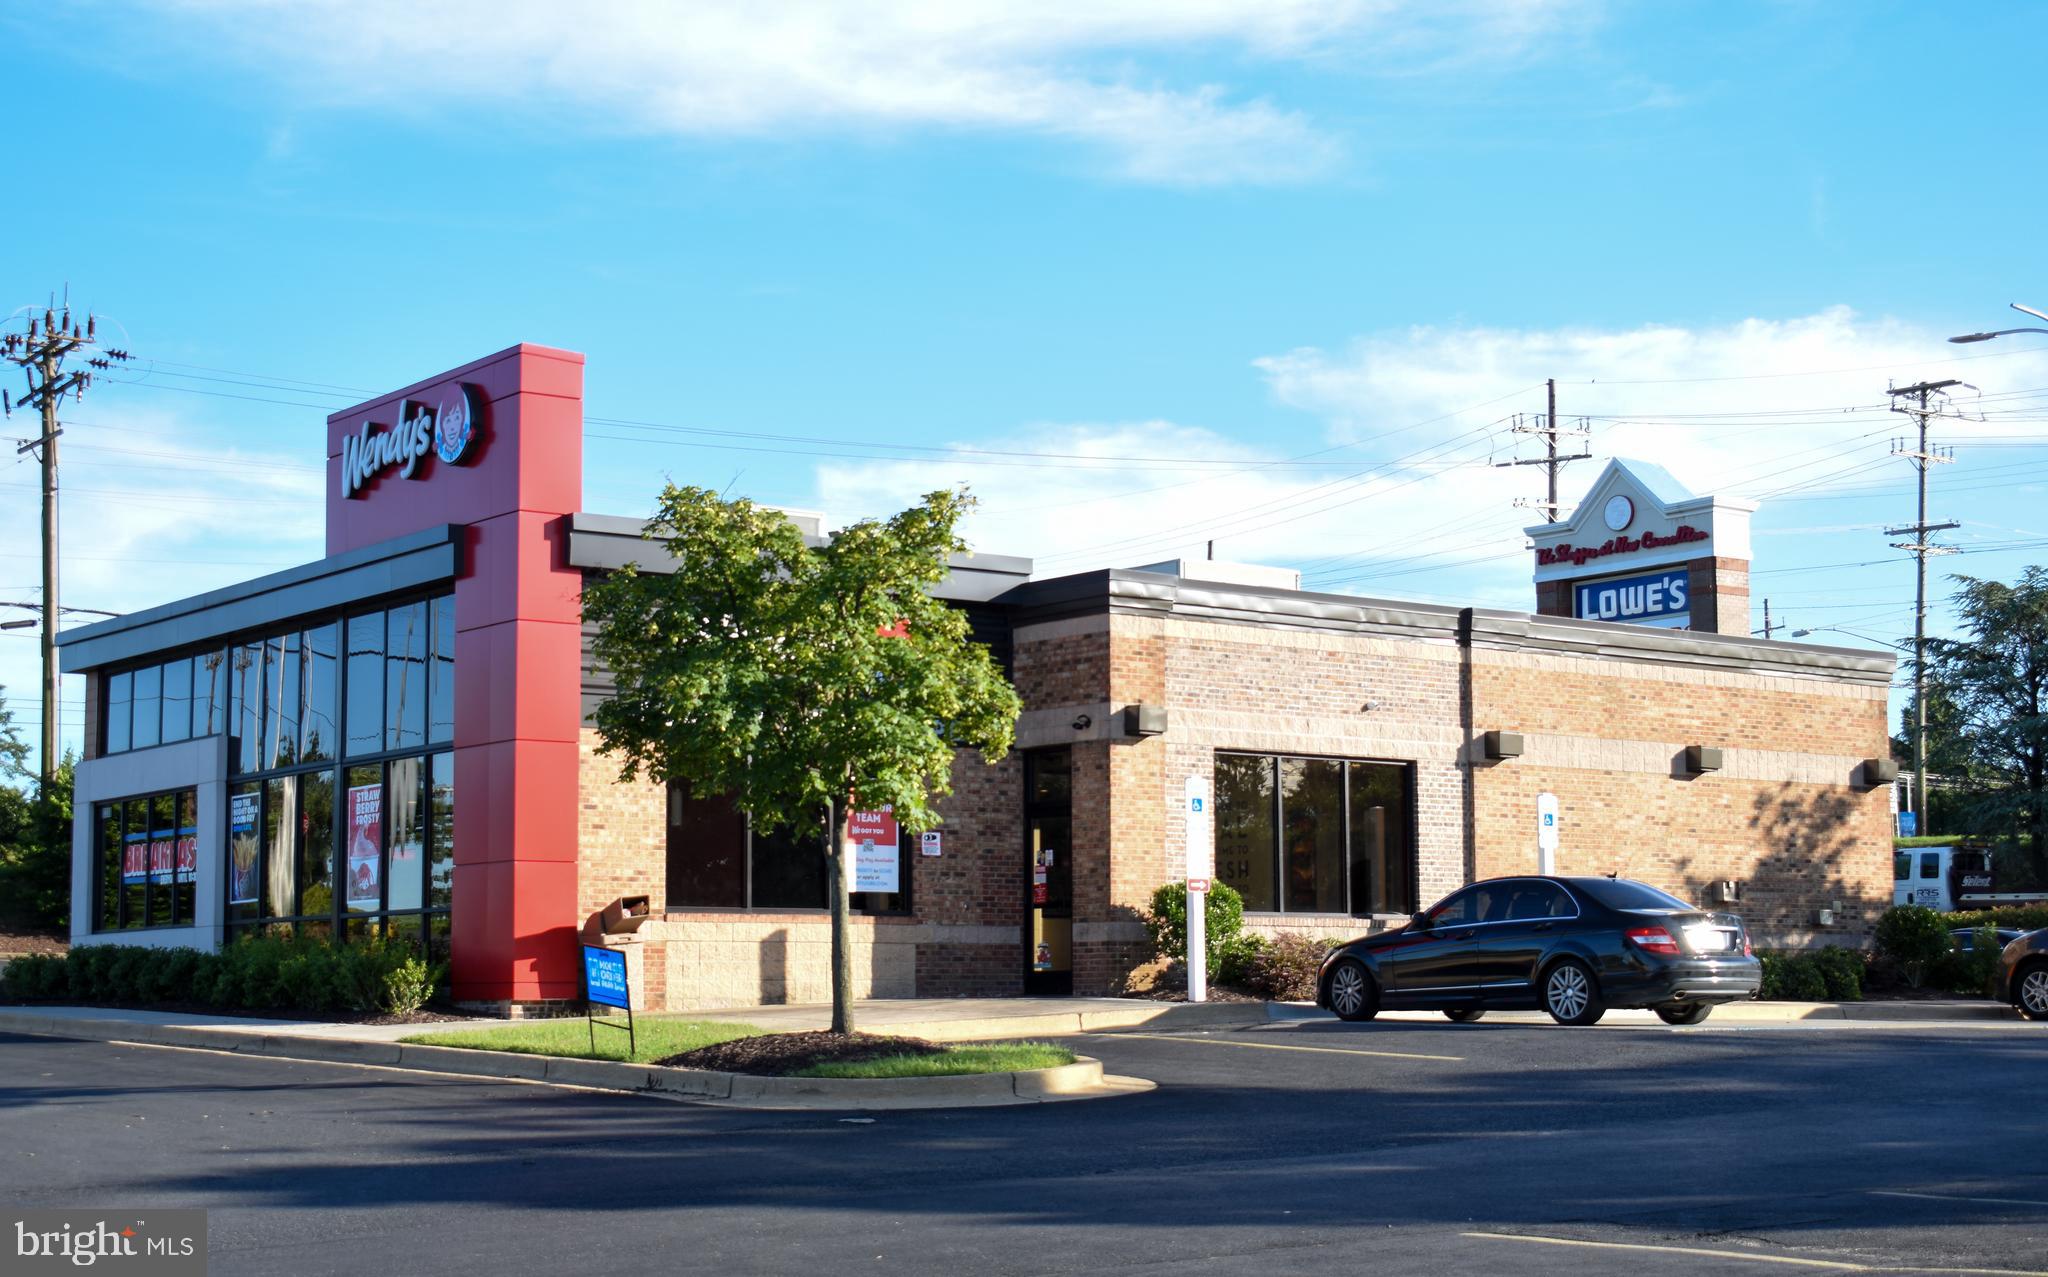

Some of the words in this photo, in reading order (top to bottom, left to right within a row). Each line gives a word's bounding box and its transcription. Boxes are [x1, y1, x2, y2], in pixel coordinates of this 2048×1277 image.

[342, 399, 431, 498] Wendy's
[1536, 548, 1555, 565] The
[1615, 536, 1640, 553] New
[1581, 576, 1686, 621] LOWE'S
[356, 790, 380, 802] STRAW
[355, 802, 380, 815] BERRY
[355, 813, 380, 825] FROSTY
[856, 813, 881, 823] TEAM
